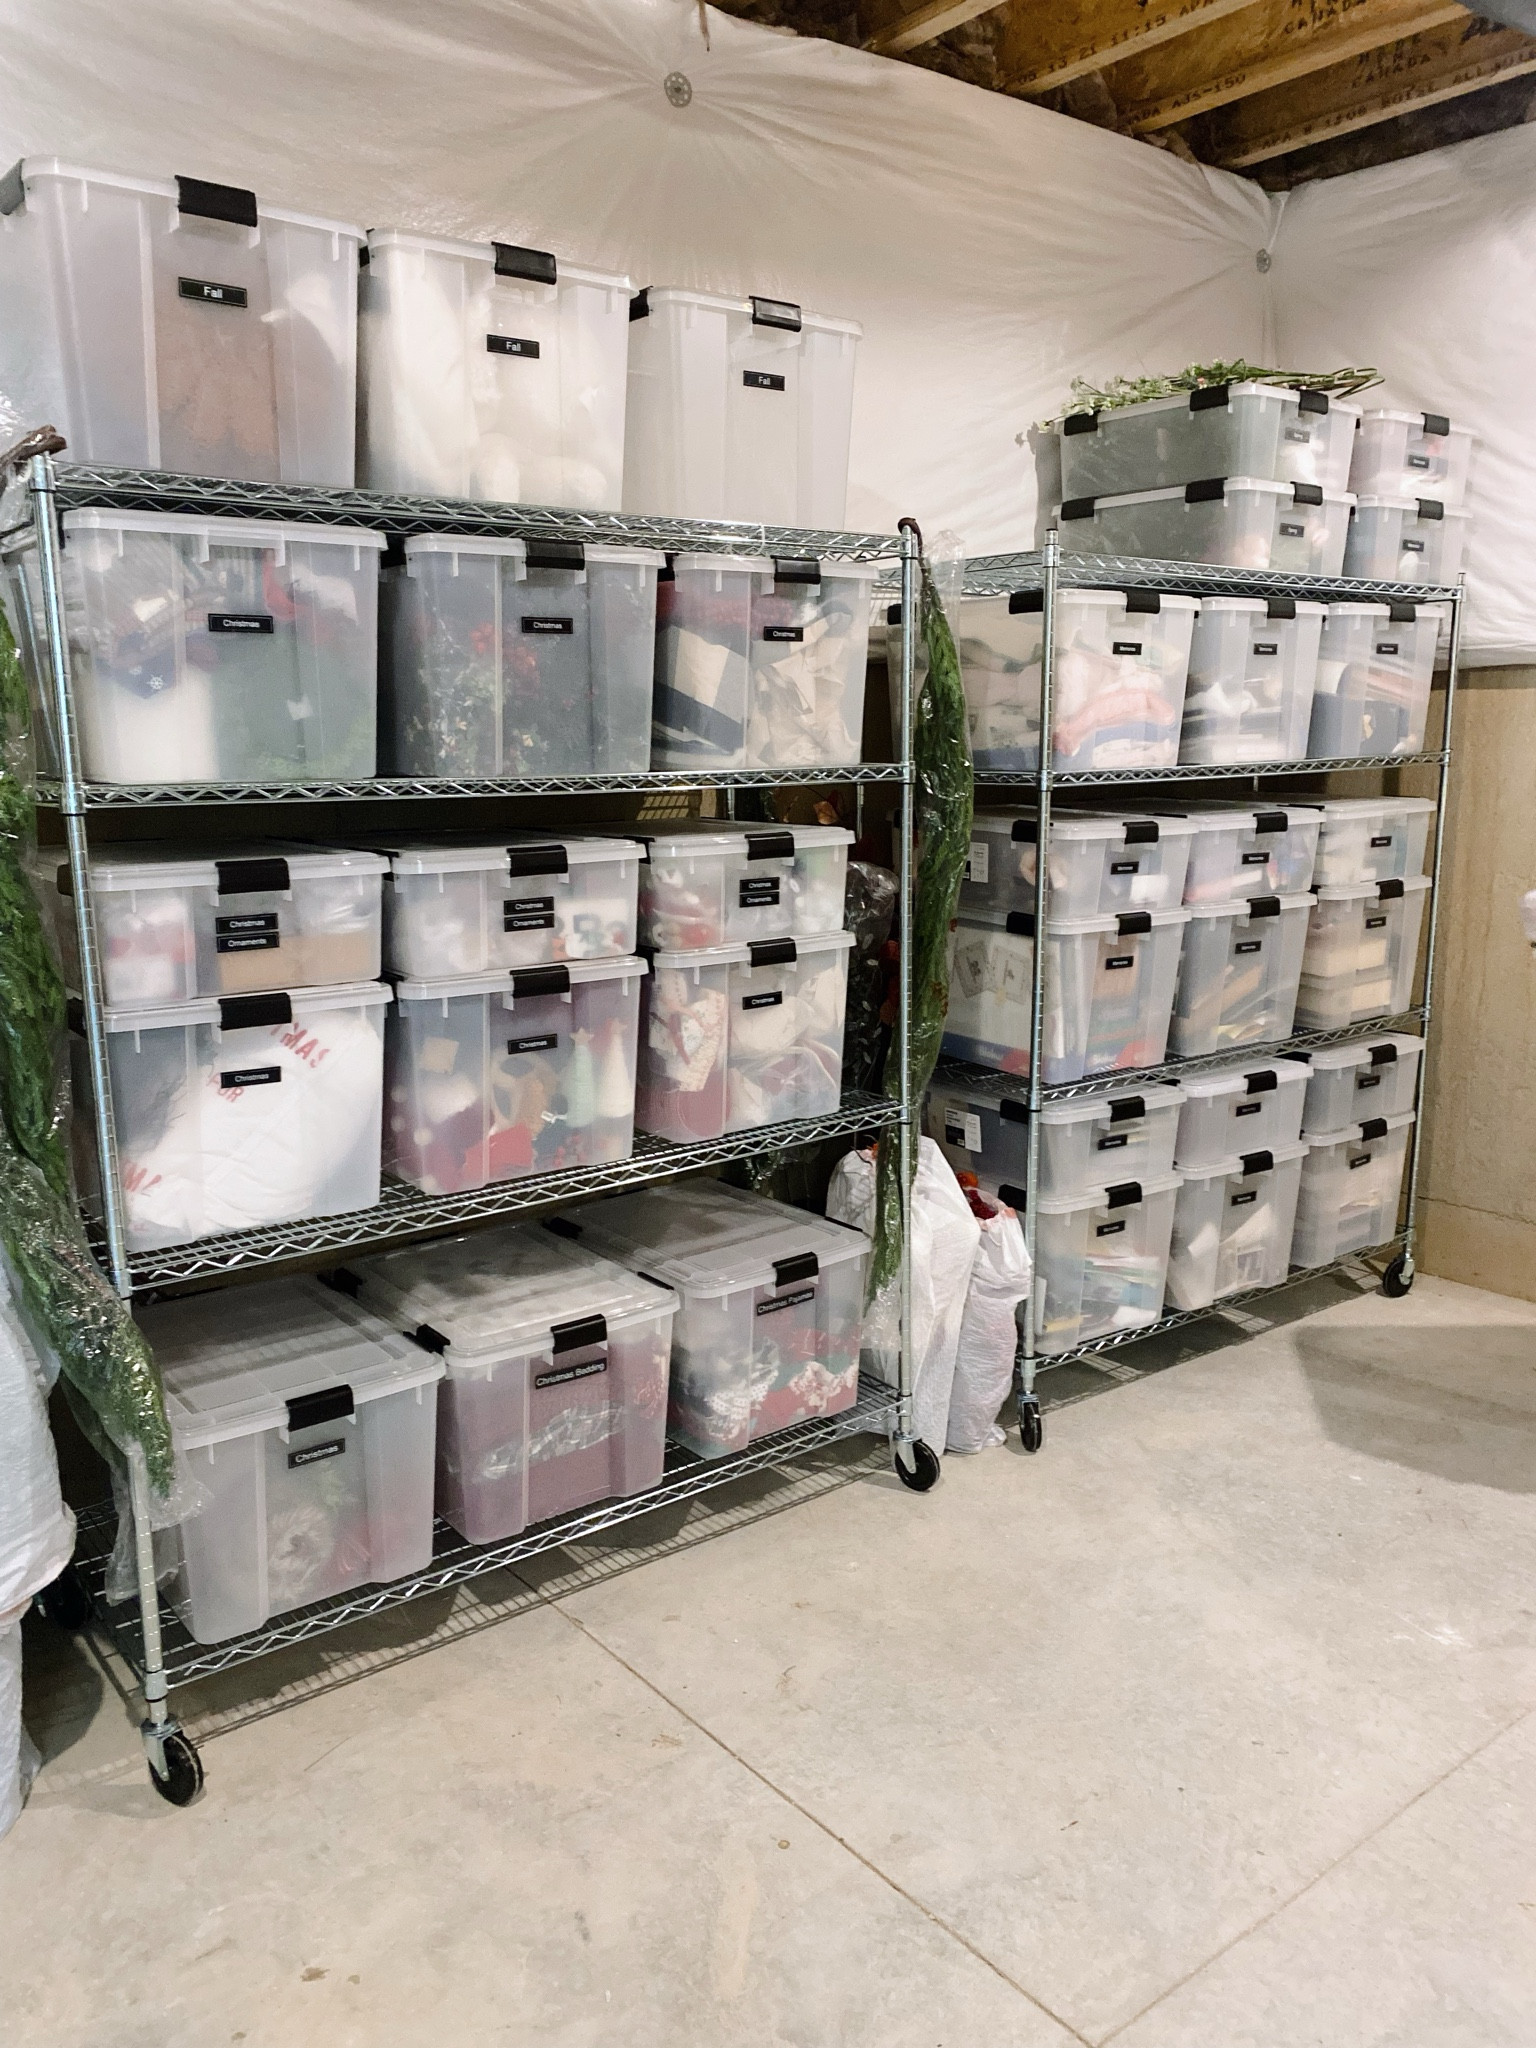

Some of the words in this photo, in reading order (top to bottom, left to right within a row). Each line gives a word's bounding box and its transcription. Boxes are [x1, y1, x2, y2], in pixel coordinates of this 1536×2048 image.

[203, 286, 223, 299] Fall
[506, 341, 521, 352] Fall
[758, 376, 771, 386] Fall
[223, 619, 260, 628] Christmas
[533, 621, 563, 630] Christmas
[749, 881, 772, 889] Christmas
[515, 902, 544, 911] Christmas
[229, 918, 265, 928] Christmas
[512, 919, 545, 928] Ornaments
[227, 938, 267, 948] Ornaments
[518, 1040, 547, 1049] Christmas
[757, 1301, 788, 1313] Christmas
[536, 1370, 574, 1387] Christmas
[575, 1362, 605, 1376] Bedding
[295, 1444, 338, 1463] Christmas
